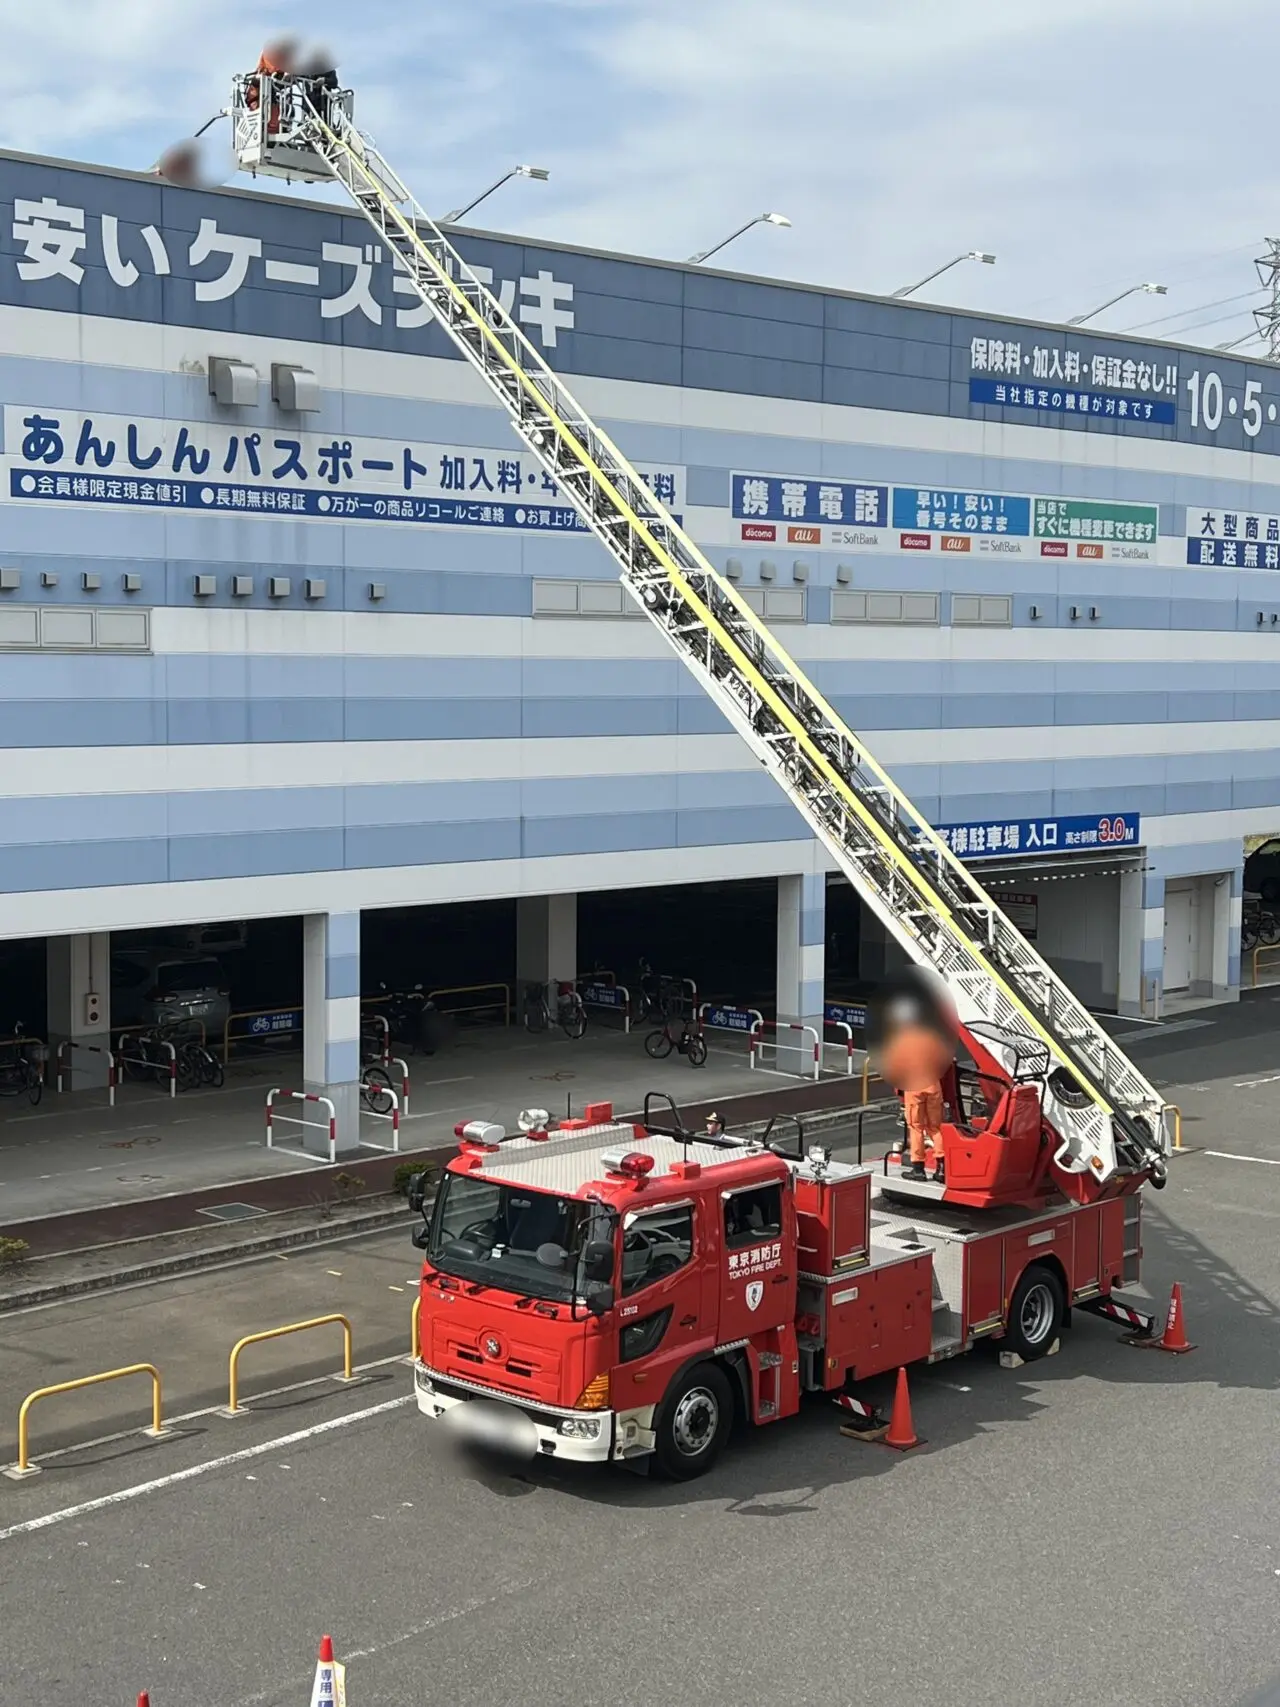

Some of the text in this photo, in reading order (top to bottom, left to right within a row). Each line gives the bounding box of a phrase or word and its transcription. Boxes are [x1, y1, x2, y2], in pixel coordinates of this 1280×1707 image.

[995, 384, 1154, 419] 当社指定の機種が対象です
[22, 414, 427, 491] あんしんパスポート
[215, 488, 306, 511] 長期無料保証
[743, 479, 879, 523] 携帯電話
[1037, 501, 1067, 515] 当店で
[916, 510, 1008, 532] 番号そのまま
[1036, 516, 1155, 541] すぐに機種変更できます
[1200, 511, 1279, 541] 大型商品
[794, 529, 814, 542] au
[843, 531, 878, 545] SoftBank
[947, 538, 964, 549] au
[990, 540, 1022, 553] SoftBank
[1082, 546, 1097, 556] au
[1121, 547, 1149, 560] SoftBank
[1200, 540, 1279, 569] 配送無料
[1025, 823, 1058, 848] 入口
[728, 1243, 781, 1271] 東京消防庁
[728, 1267, 751, 1281] TOKYO
[750, 1262, 765, 1275] FIRE
